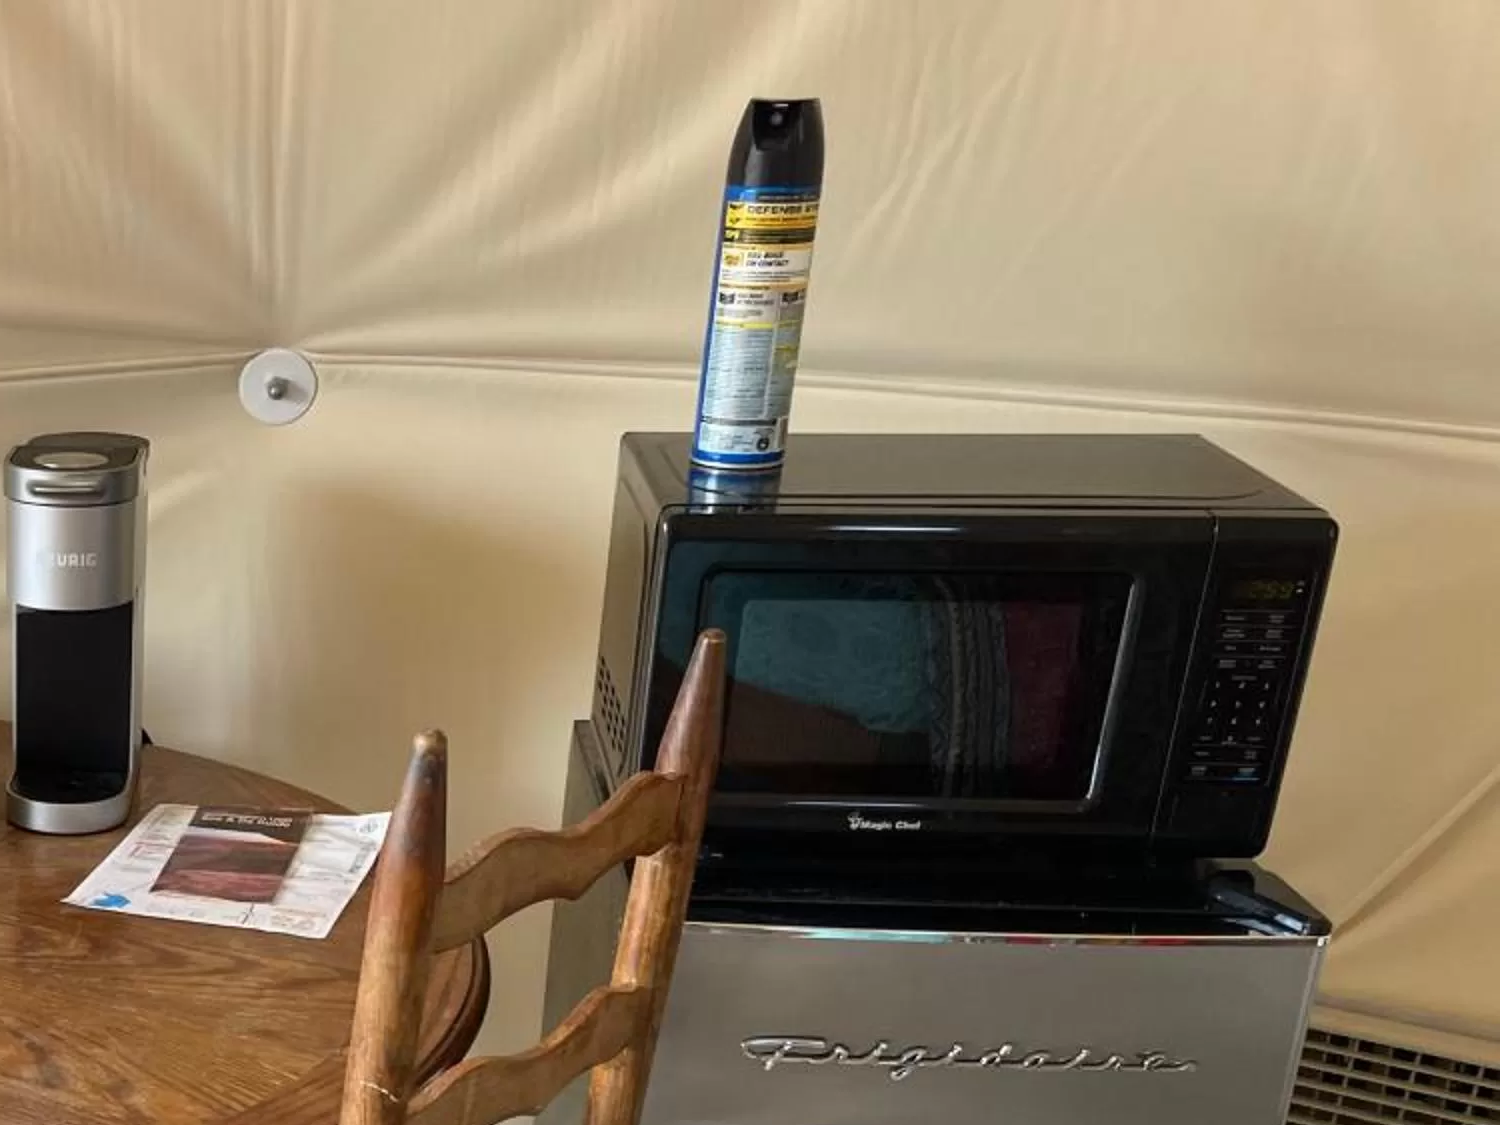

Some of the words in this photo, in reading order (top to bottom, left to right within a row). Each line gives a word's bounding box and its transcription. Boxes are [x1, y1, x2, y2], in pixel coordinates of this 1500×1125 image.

[747, 204, 802, 214] DEFENSE
[37, 551, 97, 569] URIG
[860, 820, 892, 831] Magic
[895, 820, 921, 830] Chef
[741, 1036, 1198, 1081] Frigidaire
